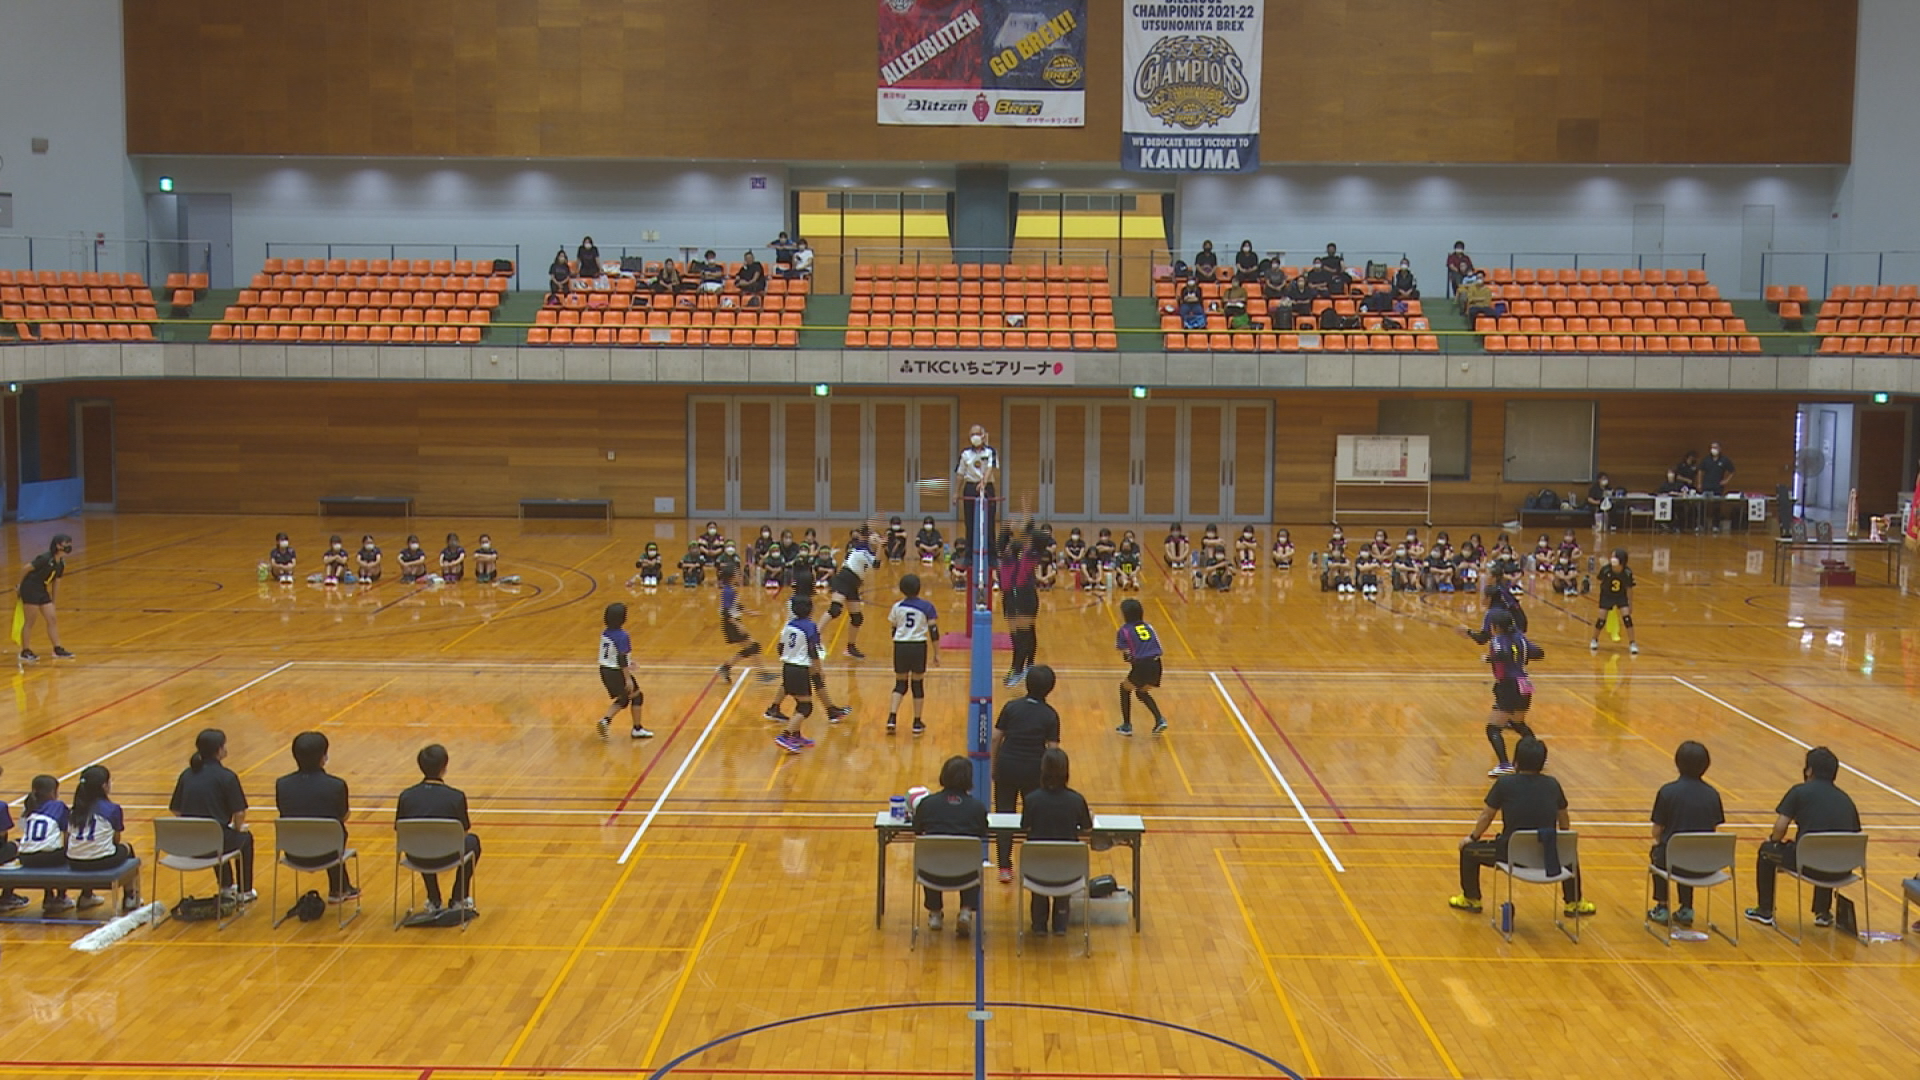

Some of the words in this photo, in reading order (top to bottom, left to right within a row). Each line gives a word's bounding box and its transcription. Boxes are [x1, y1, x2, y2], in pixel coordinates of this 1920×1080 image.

[1132, 4, 1204, 18] CHAMPIONS
[1207, 5, 1254, 18] 2021-22
[1142, 20, 1213, 31] UTSUNOMIYA
[1216, 21, 1245, 31] BREX
[989, 49, 1019, 77] GO
[1015, 9, 1077, 60] BREX!!
[1133, 52, 1249, 102] CHAMPIONS
[905, 99, 968, 112] Blitzen
[1132, 136, 1145, 147] WE
[1146, 137, 1183, 147] DEDICATE
[1185, 138, 1202, 147] THIS
[1204, 138, 1237, 147] VICTORY
[1239, 138, 1249, 147] TO
[1140, 147, 1241, 169] KANUMA
[914, 360, 1052, 376] TKCいちごアリーナ
[1611, 580, 1621, 592] 3
[905, 612, 916, 628] 5
[1135, 624, 1152, 641] 5
